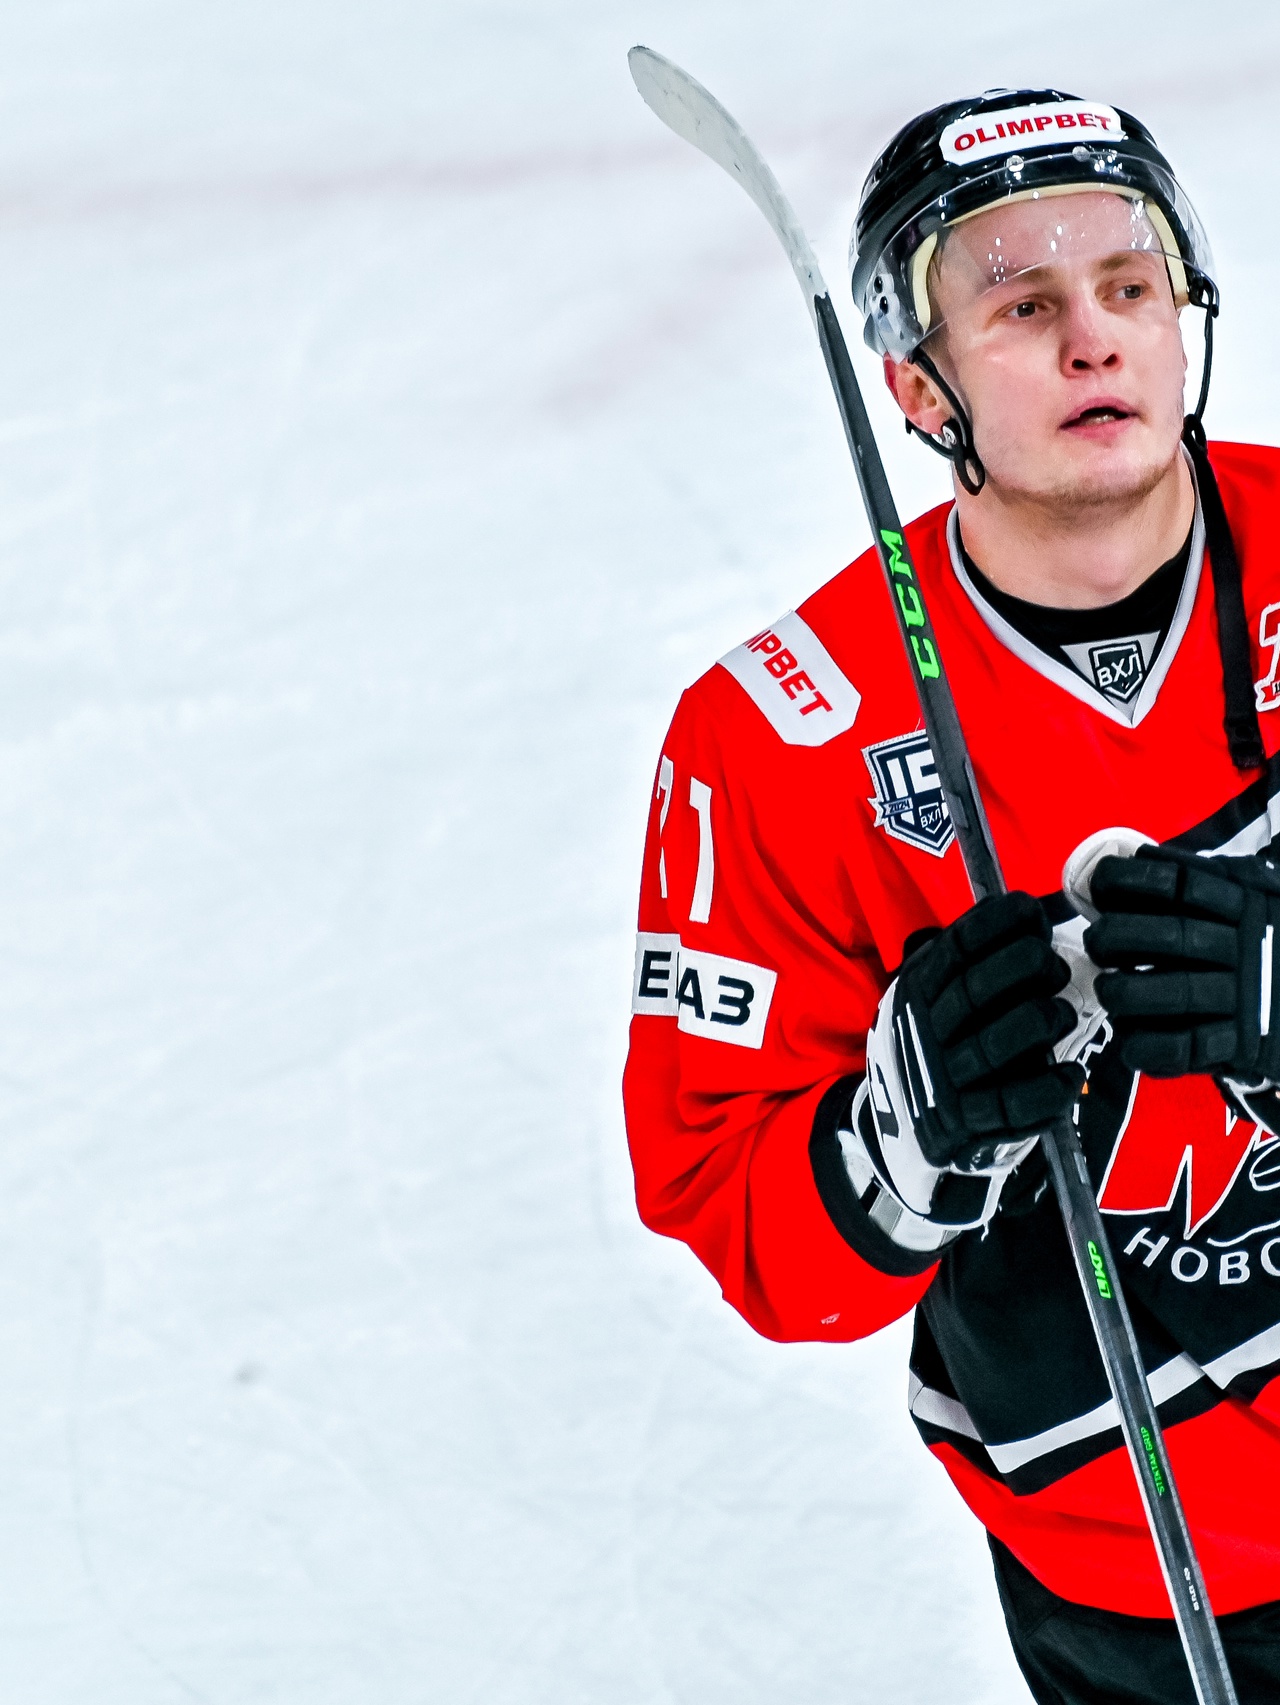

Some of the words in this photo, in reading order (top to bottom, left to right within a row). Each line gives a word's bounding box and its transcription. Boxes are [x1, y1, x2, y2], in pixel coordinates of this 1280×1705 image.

[954, 112, 1111, 152] OLIMPBET
[880, 529, 941, 681] CCM
[744, 629, 834, 716] PBET
[1096, 652, 1142, 688] ВХЛ
[920, 807, 942, 828] ВХЛ
[1140, 1426, 1153, 1451] GRIP
